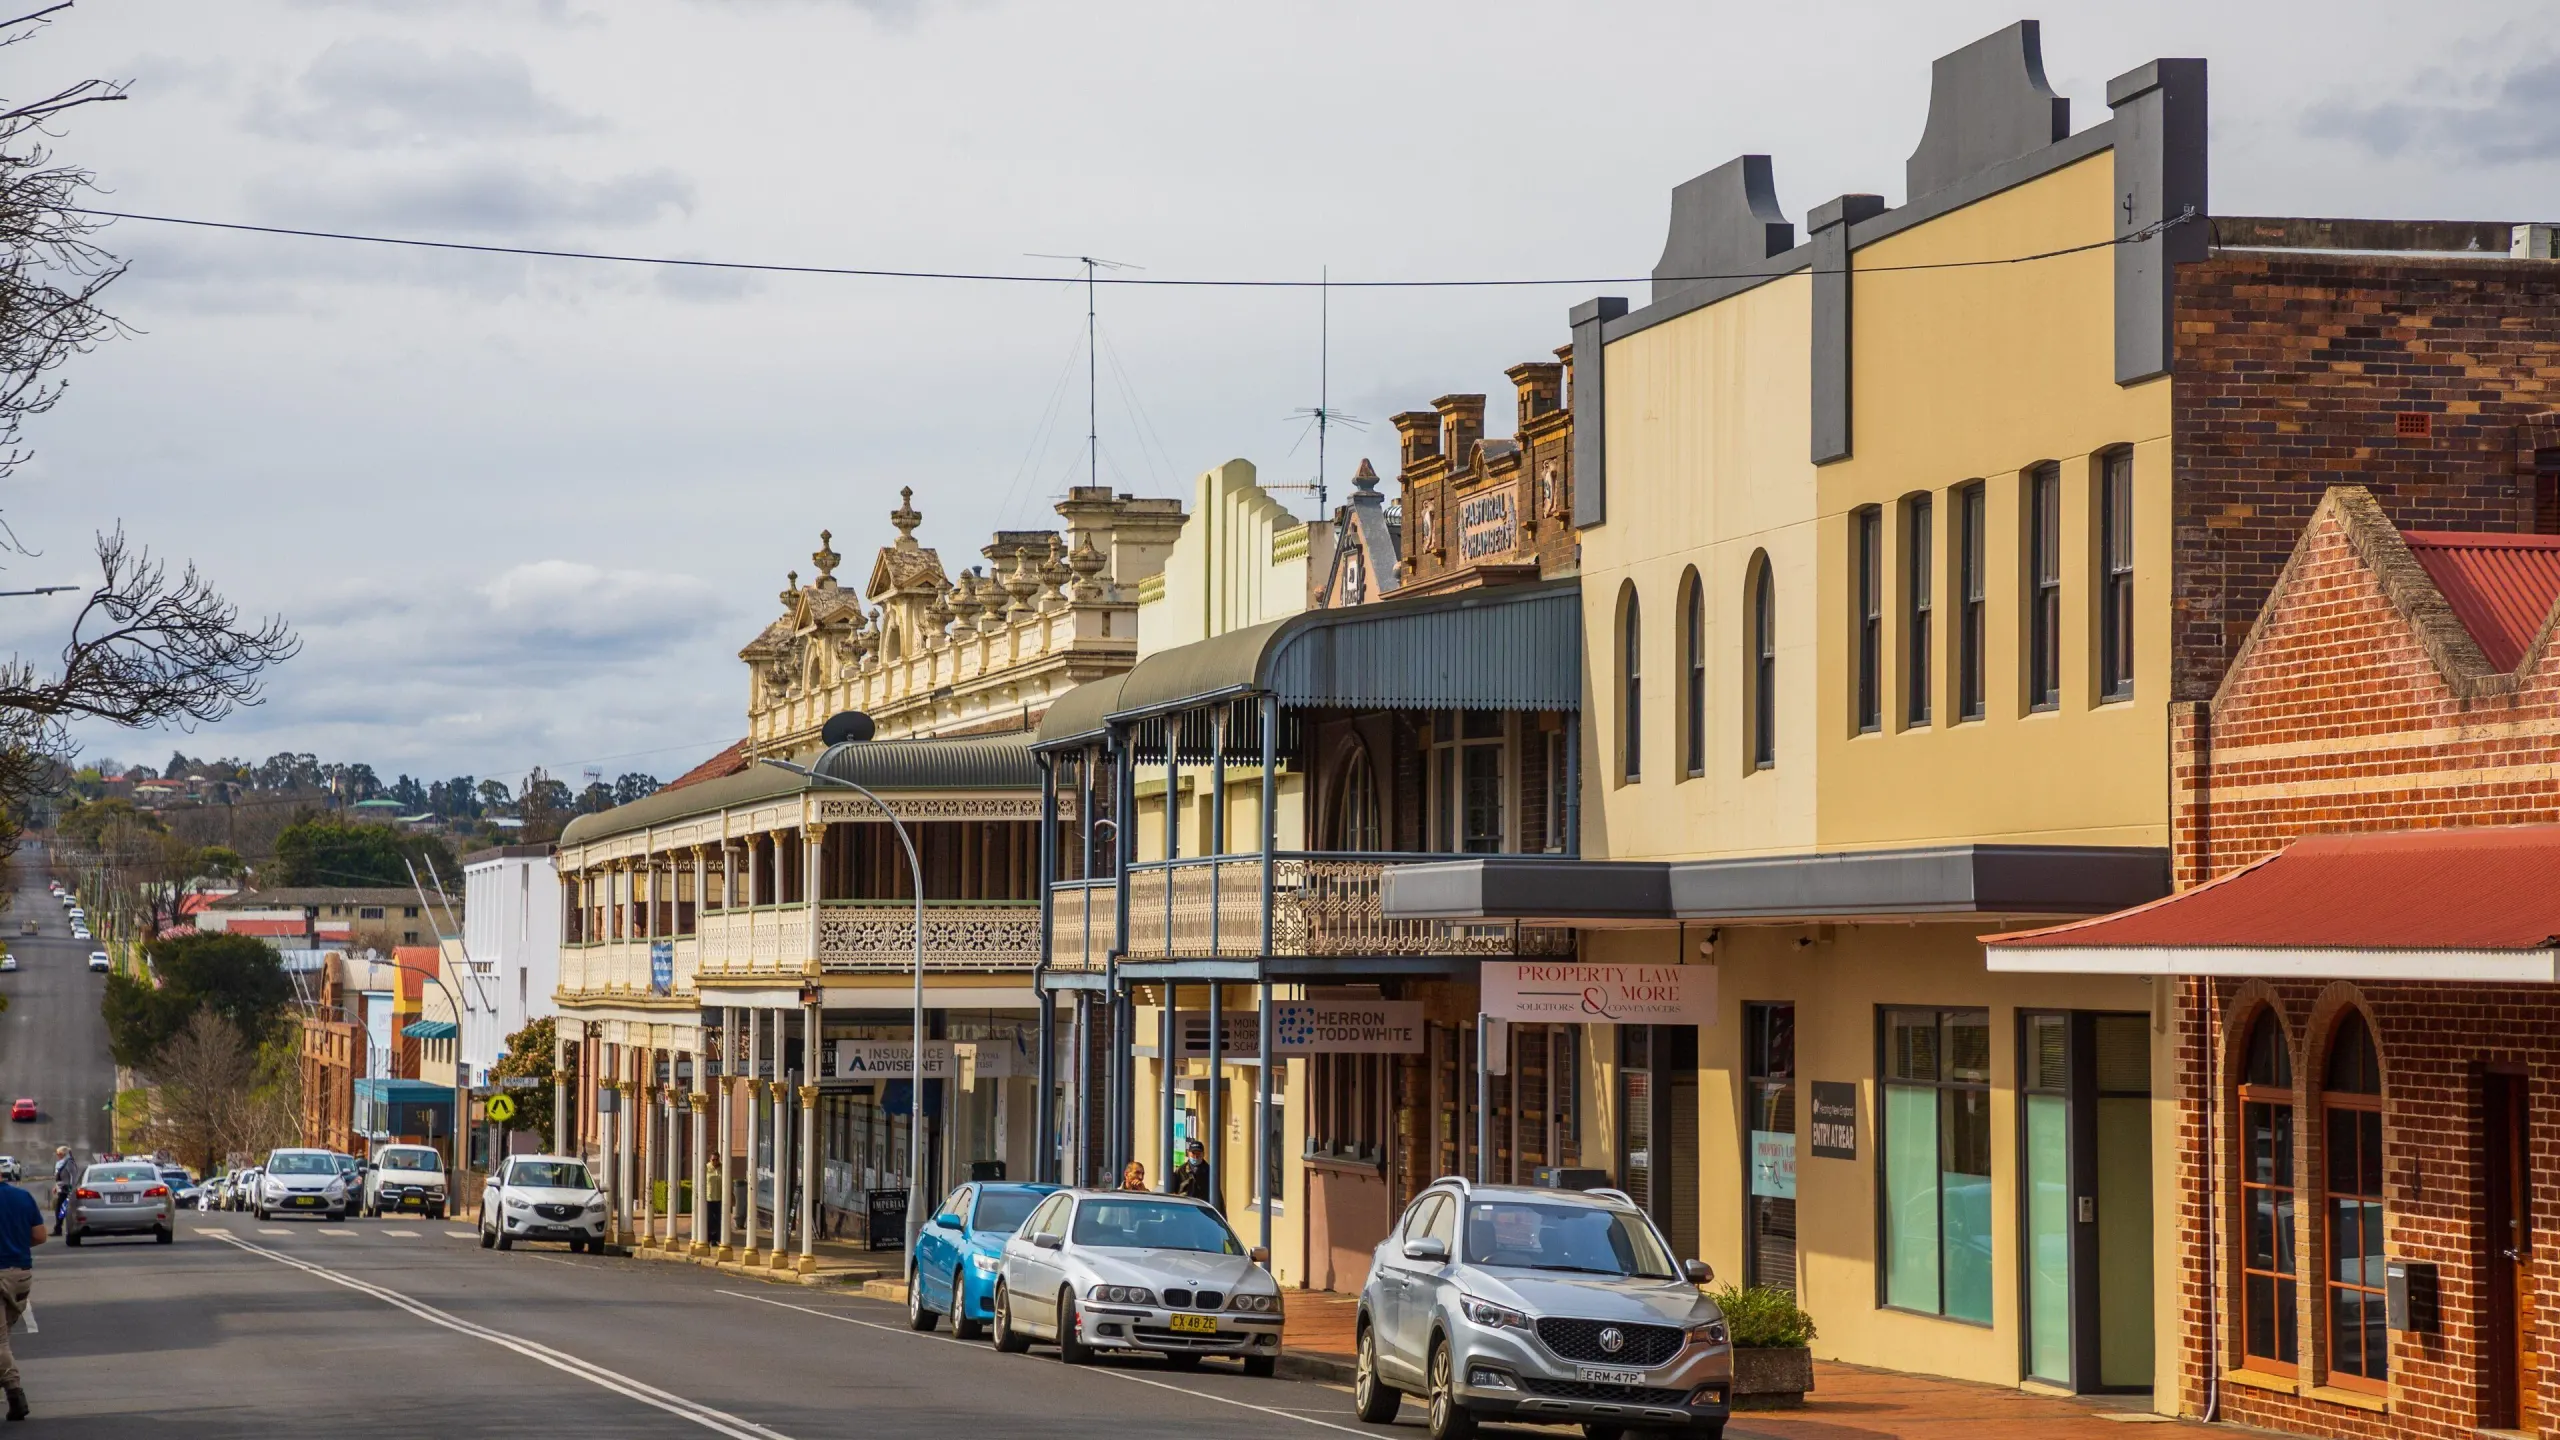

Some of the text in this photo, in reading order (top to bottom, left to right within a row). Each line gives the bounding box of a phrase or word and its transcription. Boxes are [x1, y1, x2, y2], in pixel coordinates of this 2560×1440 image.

[1465, 493, 1507, 528] PASTORAL
[1467, 526, 1512, 560] CHAMBERS
[1518, 966, 1682, 983] PROPERTY LAW
[1621, 986, 1679, 1001] MORE
[1516, 1003, 1574, 1011] SOLICITORS
[1608, 1004, 1681, 1013] CONVEYANCERS
[1316, 1012, 1385, 1025] HERRON
[1316, 1028, 1412, 1041] TODD WHITE
[868, 1060, 944, 1072] ADVISENET
[1813, 1122, 1854, 1150] ENTRY AT REAR
[1603, 1329, 1621, 1349] MG
